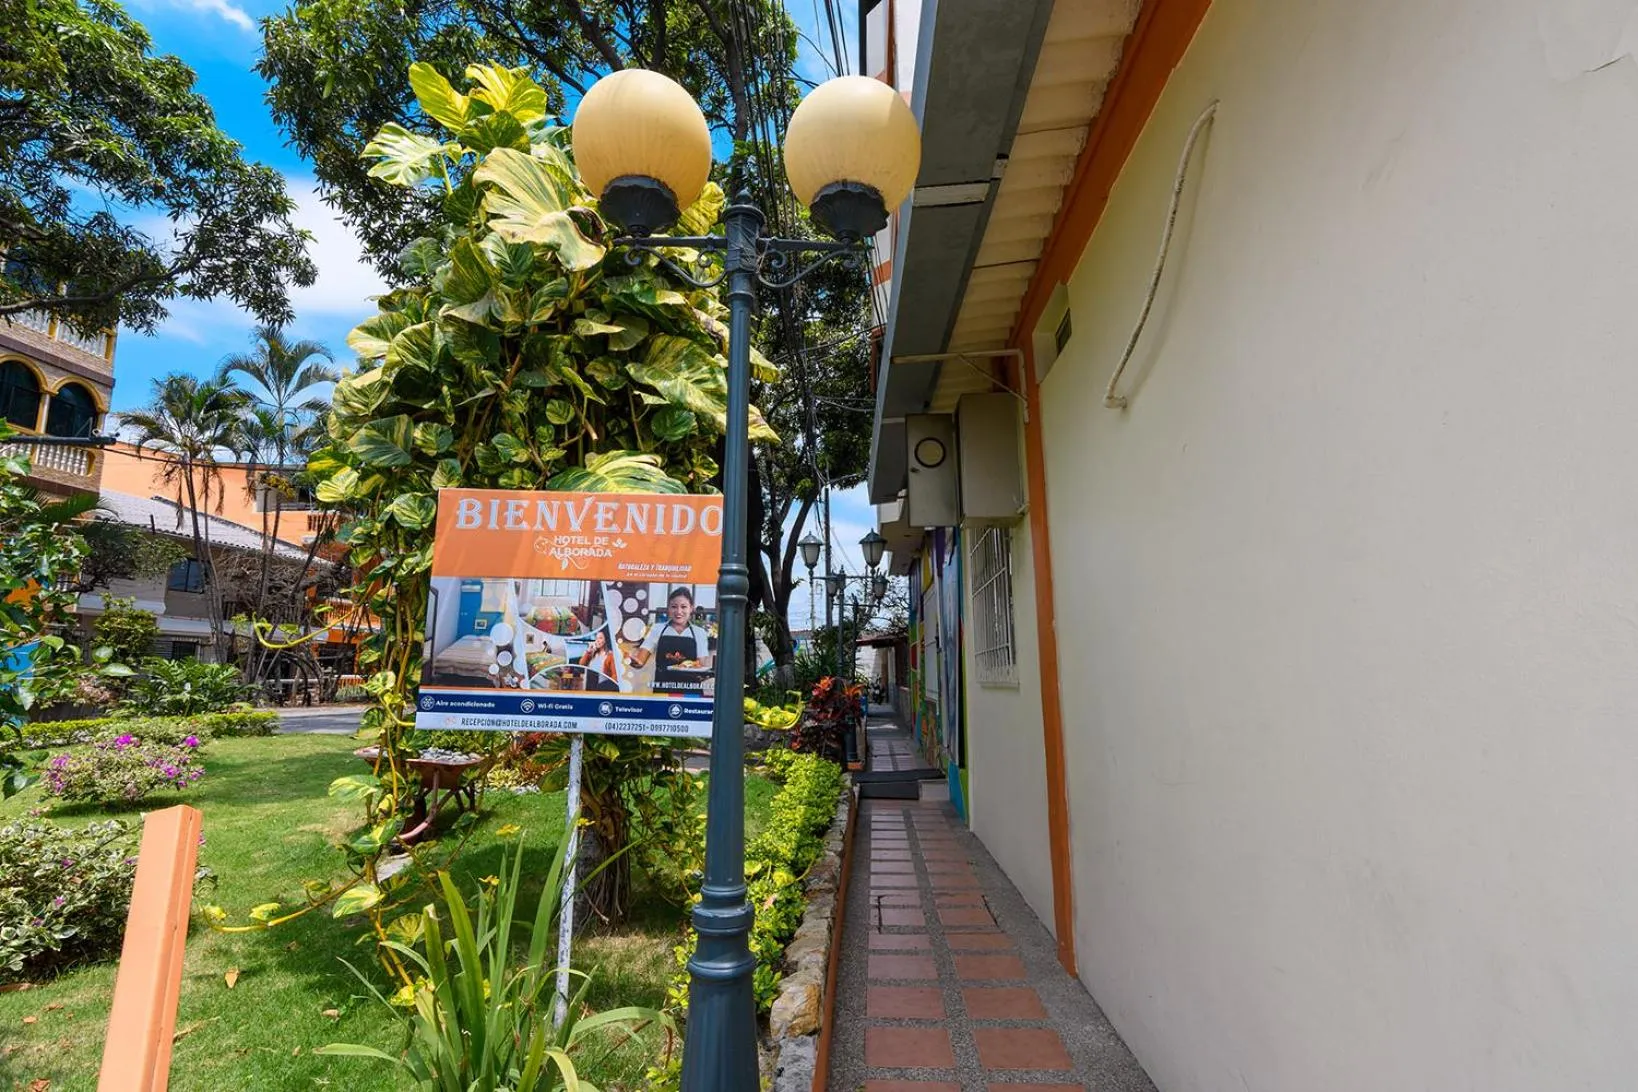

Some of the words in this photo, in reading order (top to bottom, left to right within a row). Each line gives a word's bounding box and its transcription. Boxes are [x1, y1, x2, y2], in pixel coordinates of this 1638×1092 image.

[455, 497, 723, 536] BIENVENIDO
[554, 535, 591, 546] HOTEL
[594, 536, 609, 546] DE
[549, 546, 612, 558] ALBORADA
[435, 699, 449, 707] Aire
[449, 699, 496, 709] acondicionado
[554, 703, 574, 711] Gratis
[615, 705, 643, 714] Televisor
